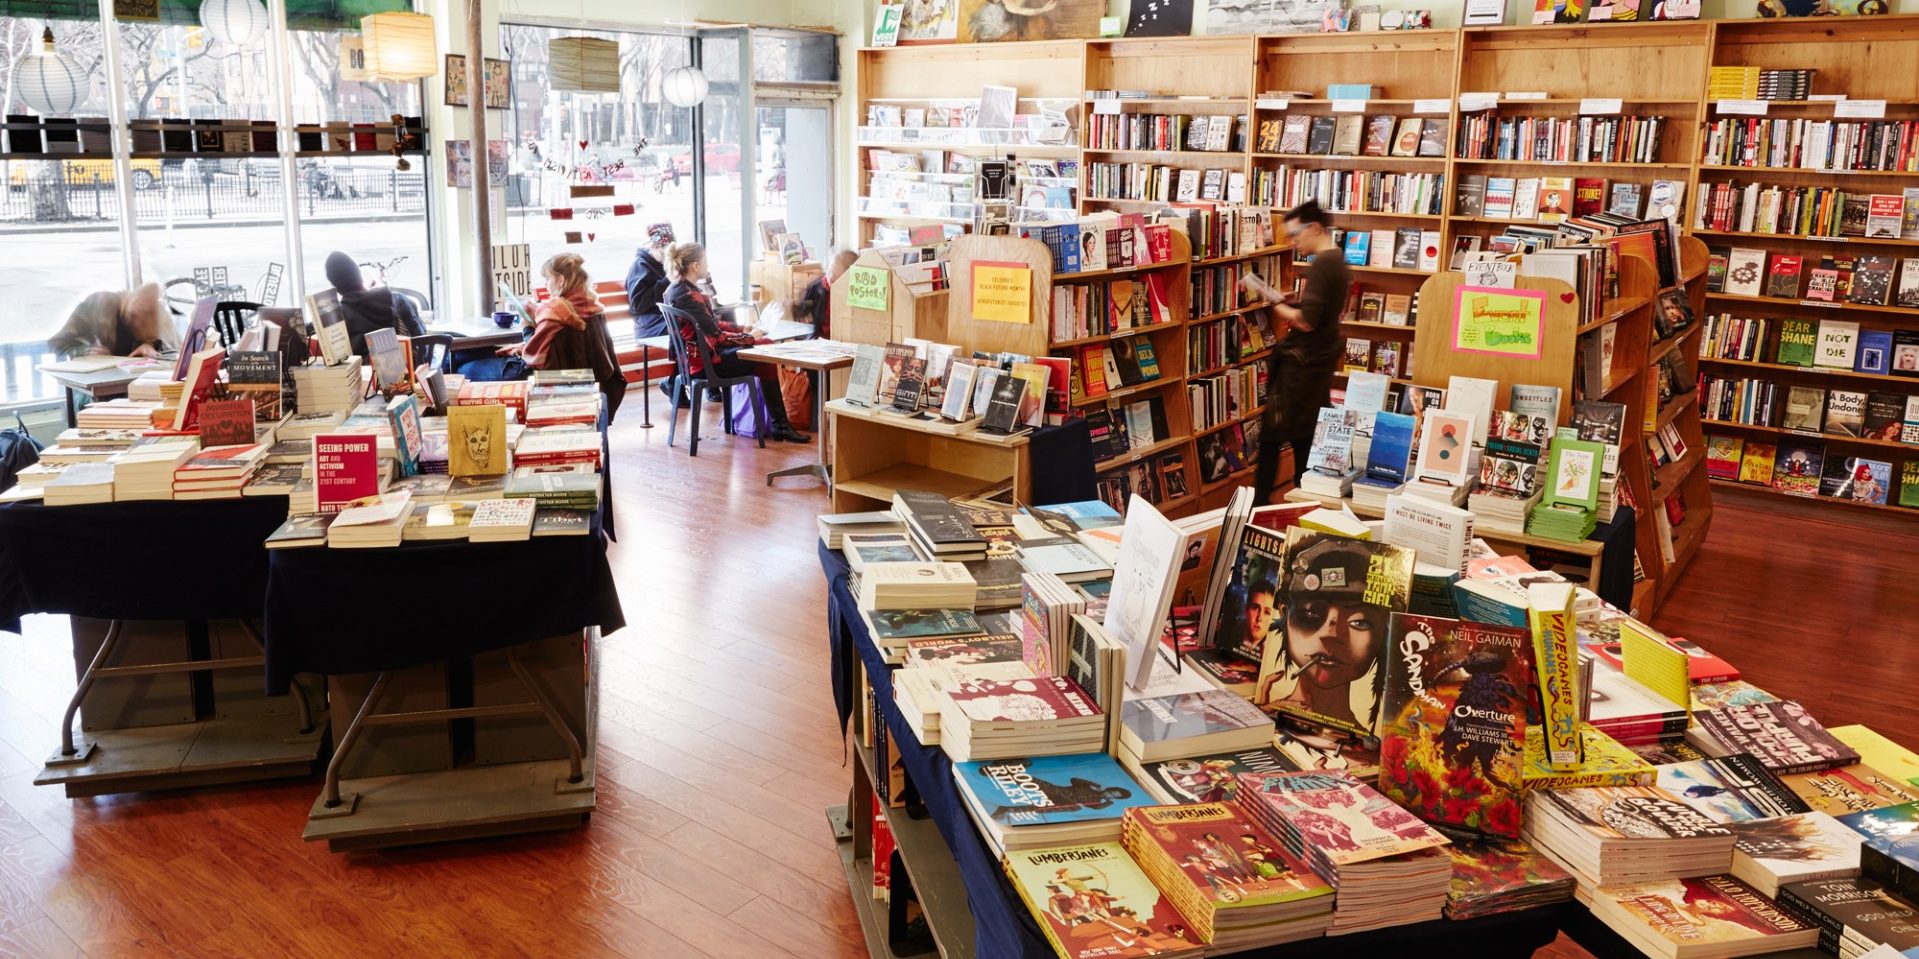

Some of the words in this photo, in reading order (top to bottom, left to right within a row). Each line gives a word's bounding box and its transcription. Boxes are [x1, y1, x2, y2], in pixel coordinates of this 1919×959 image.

[1576, 188, 1602, 202] STRIKE!
[1782, 320, 1811, 332] DEAR
[1780, 332, 1815, 345] SHANE
[1825, 333, 1852, 344] NOT
[1826, 347, 1847, 358] DIE
[1515, 394, 1554, 403] UNSETTLED
[1840, 394, 1863, 405] Body
[1327, 426, 1352, 435] STATE
[318, 444, 343, 453] SEEING
[344, 444, 369, 453] POWER
[1396, 509, 1409, 519] MUST
[1417, 516, 1434, 526] LIVING
[1435, 521, 1452, 531] TWICE
[1464, 525, 1472, 546] MUST
[1463, 549, 1470, 558] BE
[1460, 561, 1469, 580] LIVIN
[1362, 592, 1392, 608] GIRL
[915, 640, 955, 650] WORLD
[1450, 630, 1474, 643] NEIL
[1475, 633, 1521, 648] GAIMAN
[1551, 613, 1573, 706] VIDEOGAMES
[1454, 705, 1516, 723] Overture
[1461, 732, 1480, 742] DAVE
[1482, 735, 1513, 745] STEWART
[1466, 727, 1500, 739] WILLIAMS
[986, 765, 1034, 805] RILEY
[1005, 764, 1056, 808] BOOTS
[1522, 774, 1604, 791] VIDEOGAMES
[1153, 807, 1225, 823] LUMBERJANES
[1027, 849, 1109, 866] LUMBERJANES
[1819, 882, 1857, 893] TONI
[1814, 890, 1877, 903] MORRISO
[1781, 890, 1795, 900] GOD
[1795, 897, 1810, 909] HELP
[1822, 915, 1843, 930] CHILD
